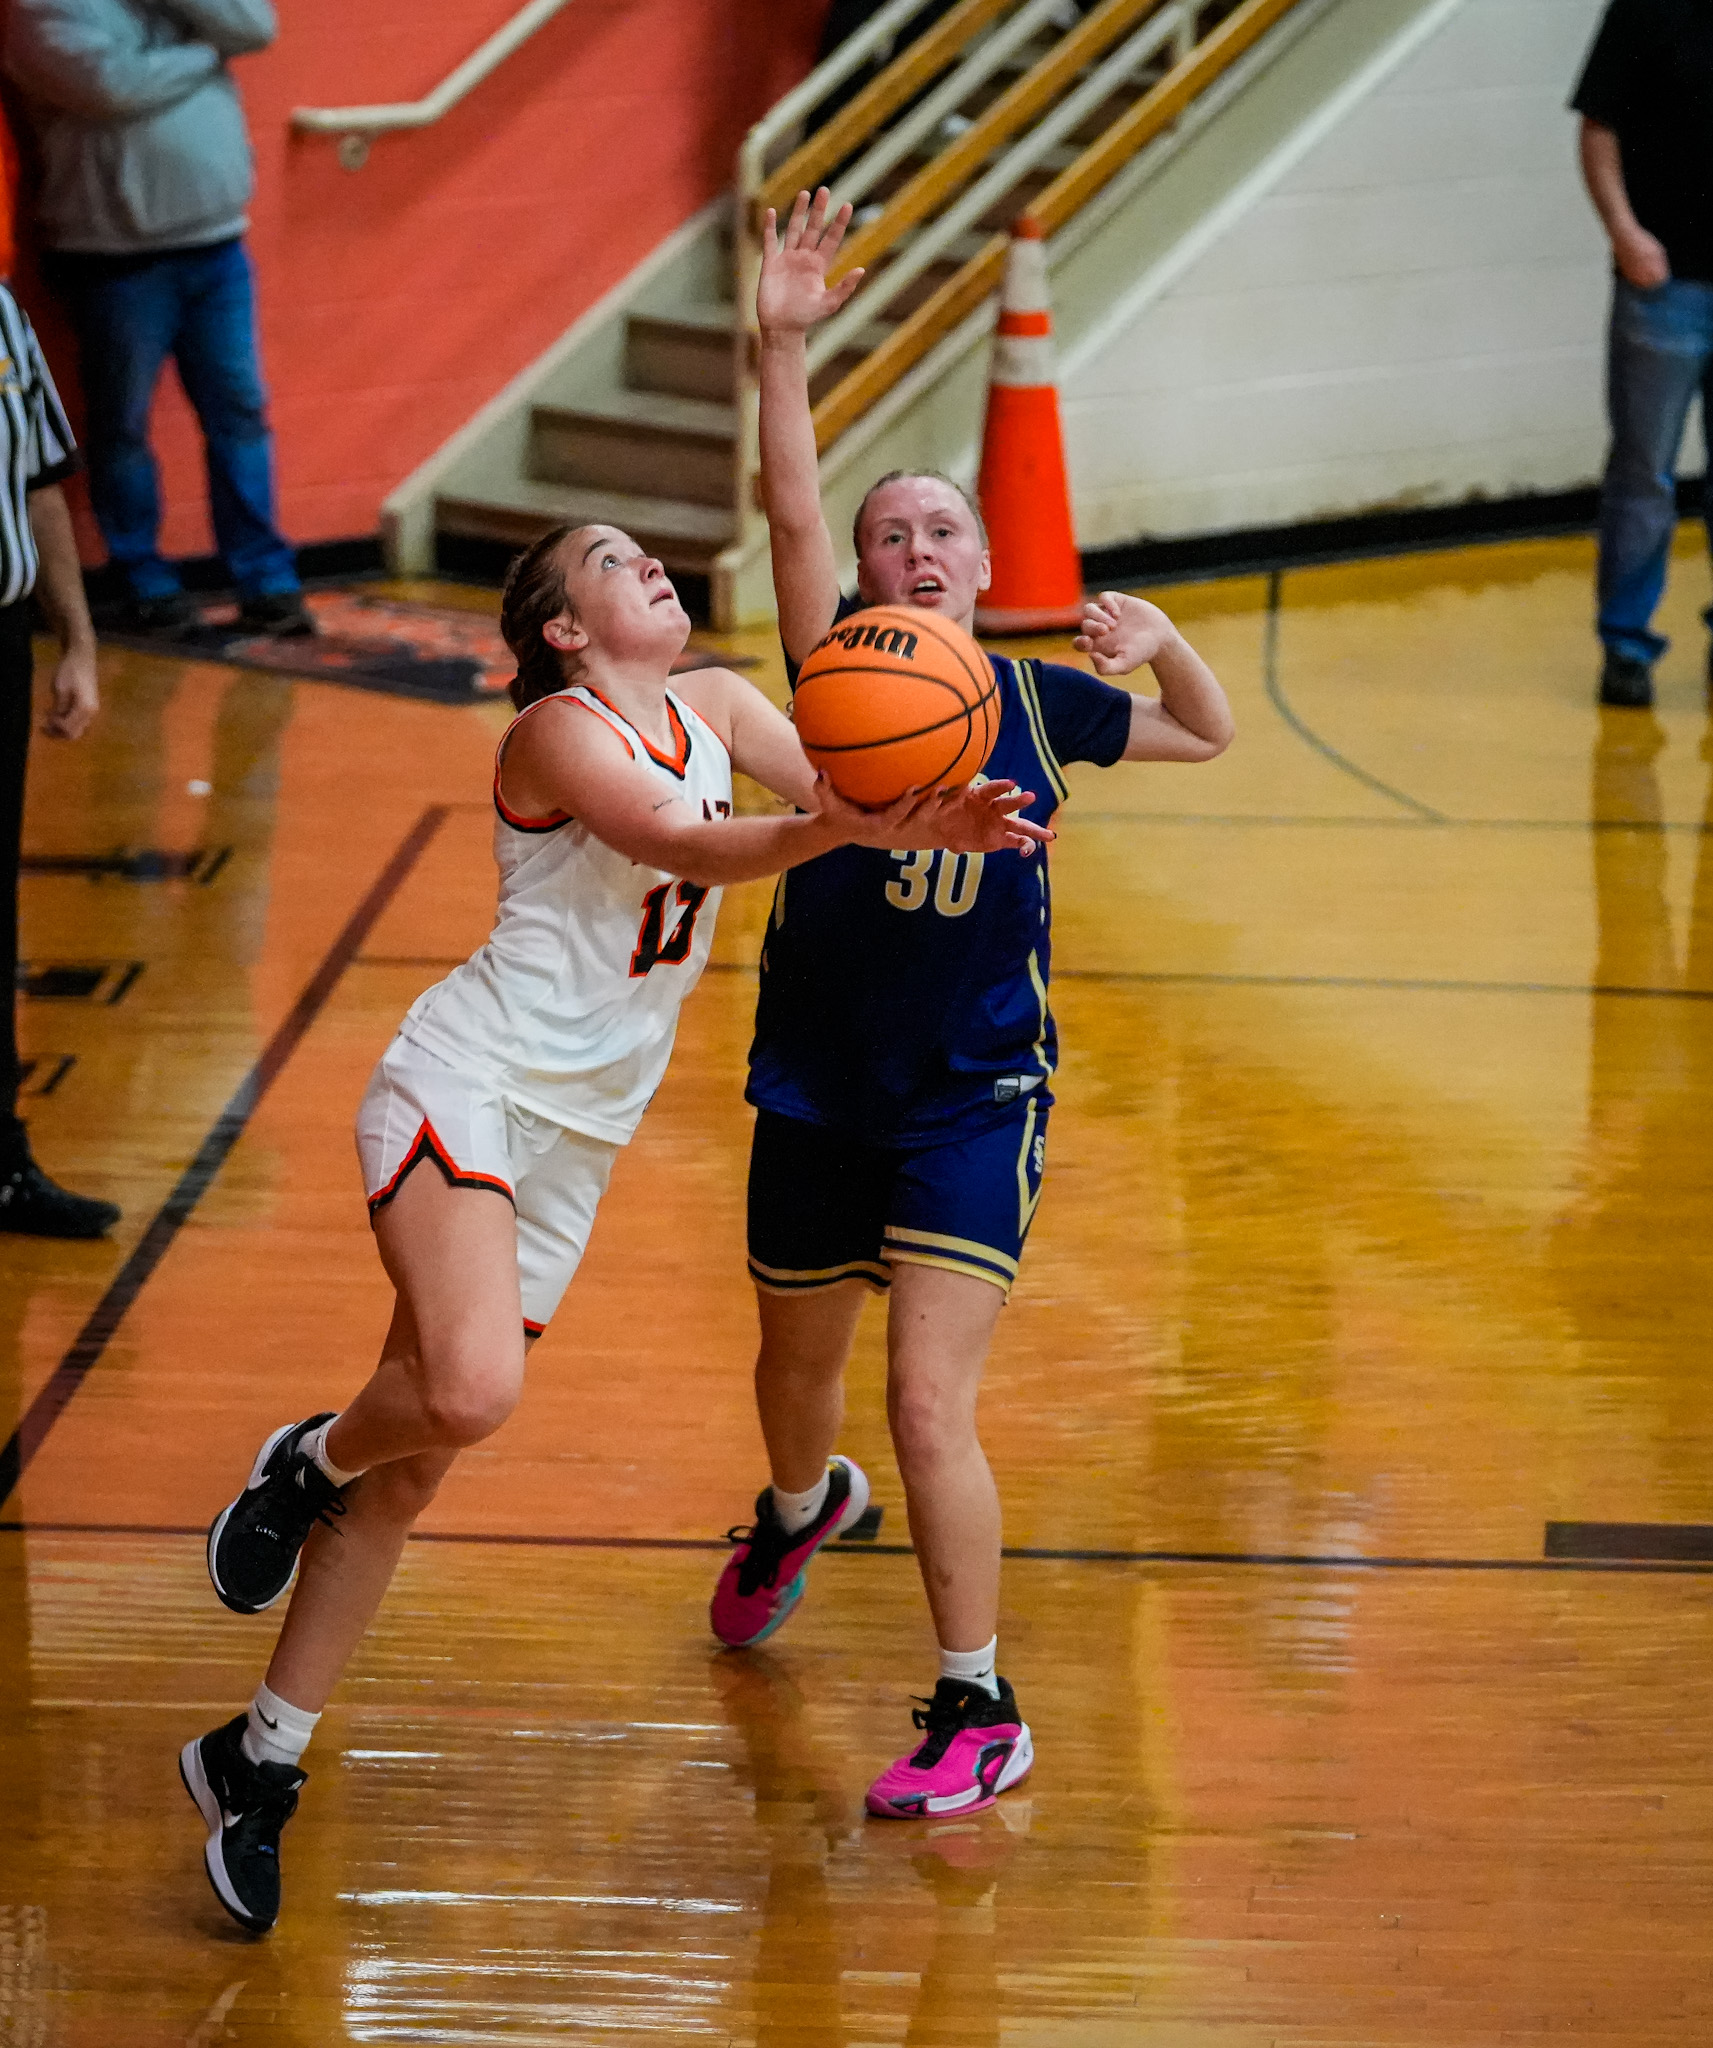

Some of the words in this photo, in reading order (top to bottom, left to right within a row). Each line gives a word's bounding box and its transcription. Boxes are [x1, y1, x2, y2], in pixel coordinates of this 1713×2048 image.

[808, 624, 918, 661] Wilso
[885, 848, 985, 917] 30
[629, 880, 711, 978] 13
